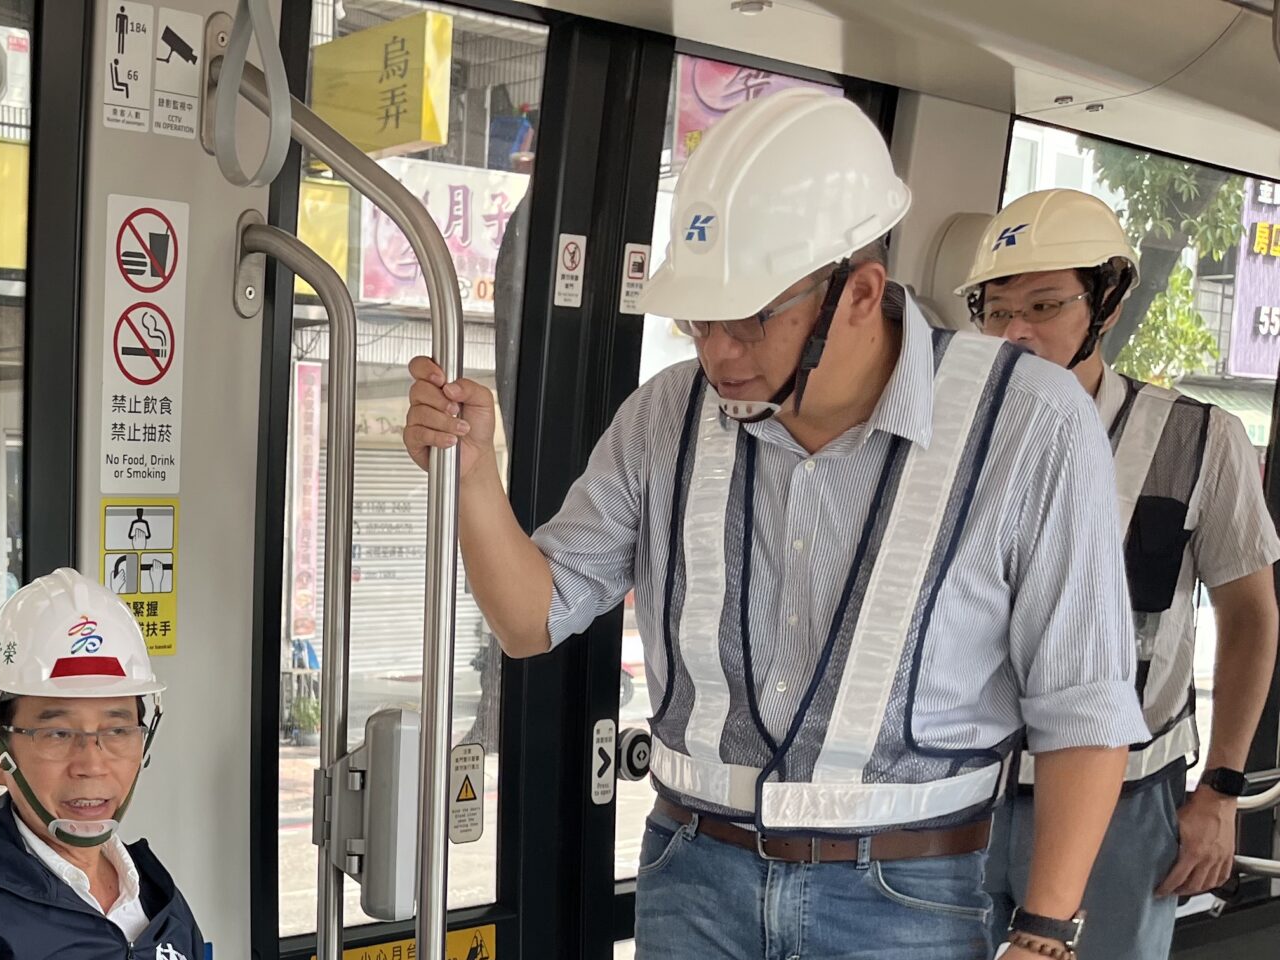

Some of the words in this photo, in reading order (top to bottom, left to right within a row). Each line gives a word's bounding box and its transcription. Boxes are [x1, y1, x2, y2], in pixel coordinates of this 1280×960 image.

[130, 22, 147, 34] 184
[127, 70, 139, 81] 66
[167, 114, 183, 123] CCTV
[154, 121, 161, 129] IN
[162, 122, 194, 134] OPERATION
[111, 394, 173, 415] 禁止飲食
[111, 422, 172, 442] 禁止抽菸
[106, 454, 119, 464] No
[122, 454, 148, 467] Food,
[150, 454, 175, 466] Drink
[114, 470, 124, 478] or
[126, 467, 166, 481] Smoking
